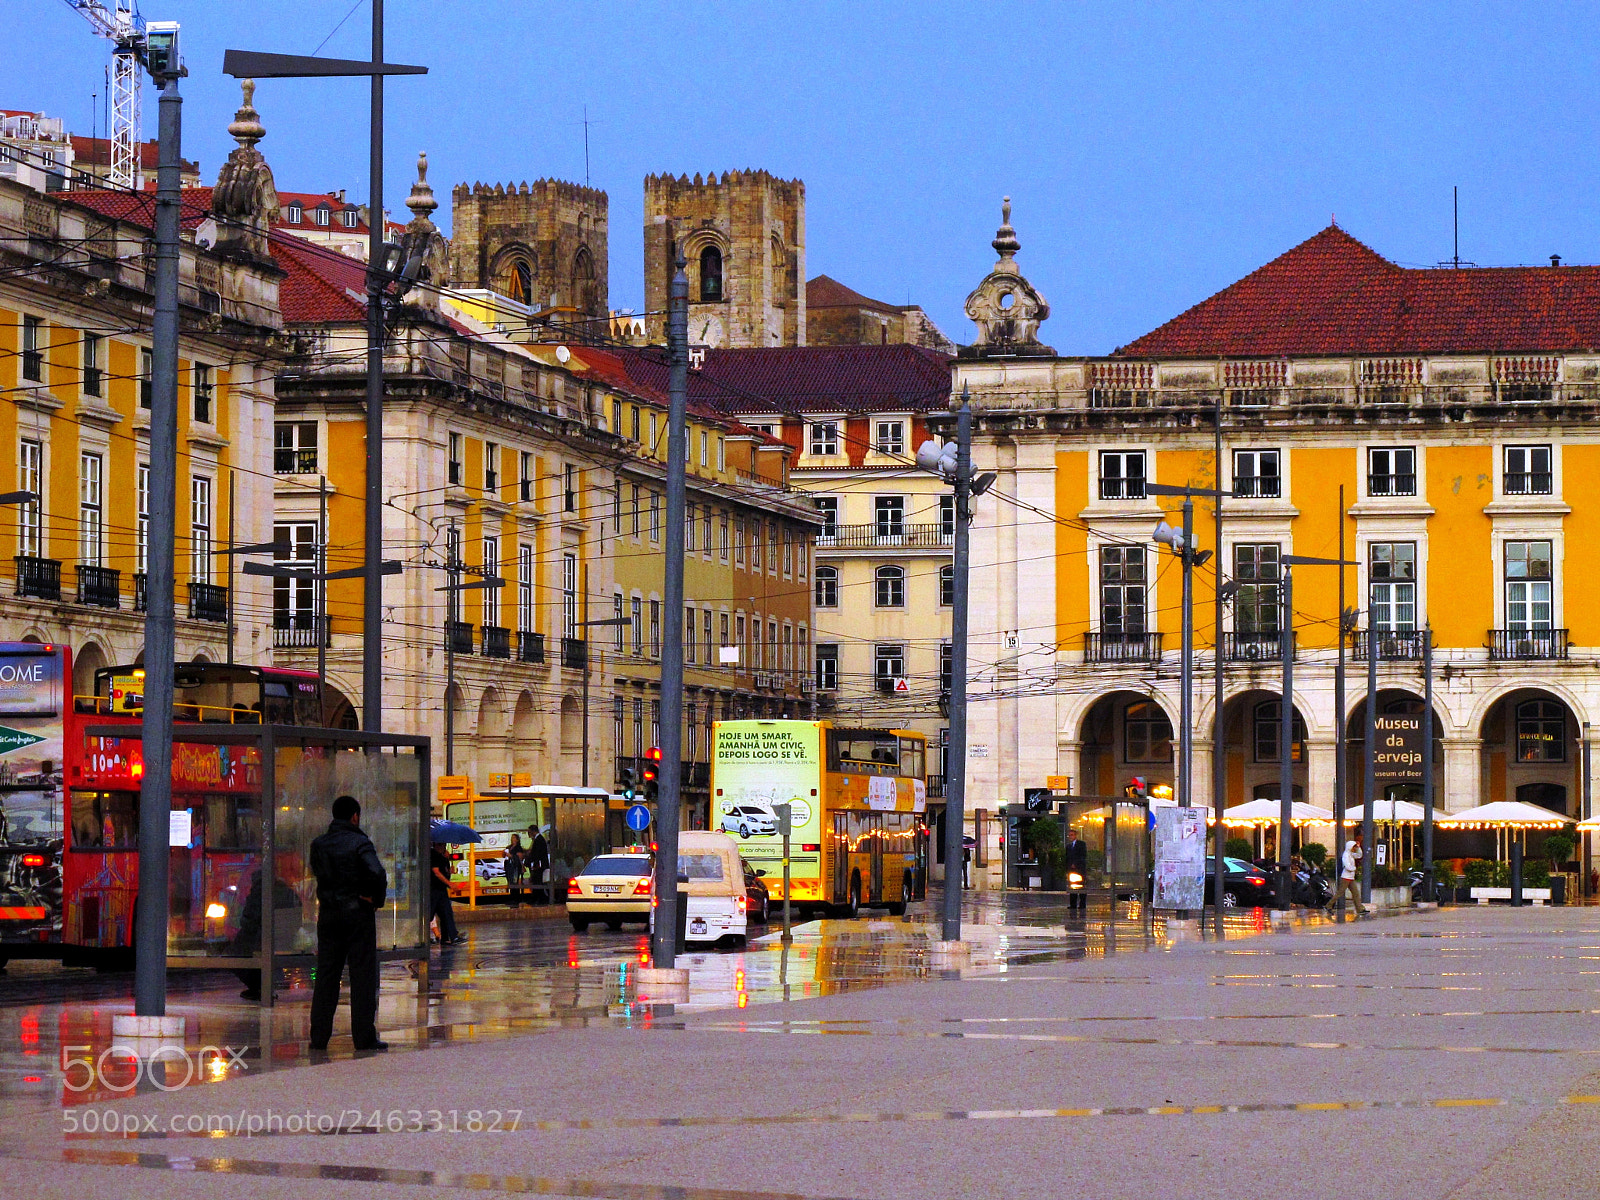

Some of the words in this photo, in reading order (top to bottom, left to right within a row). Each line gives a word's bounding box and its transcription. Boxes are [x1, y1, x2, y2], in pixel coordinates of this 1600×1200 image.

[1007, 637, 1016, 645] 15
[718, 732, 742, 740] HOJE
[744, 732, 759, 740] UM
[761, 732, 793, 741] SMART,
[1386, 734, 1404, 747] da
[718, 739, 761, 750] AMANHÃ
[762, 741, 778, 750] UM
[780, 741, 806, 750] CIVIC.
[718, 751, 750, 759] DEPOIS
[752, 751, 779, 759] LOGO
[781, 751, 791, 759] SE
[793, 748, 807, 759] VÊ.
